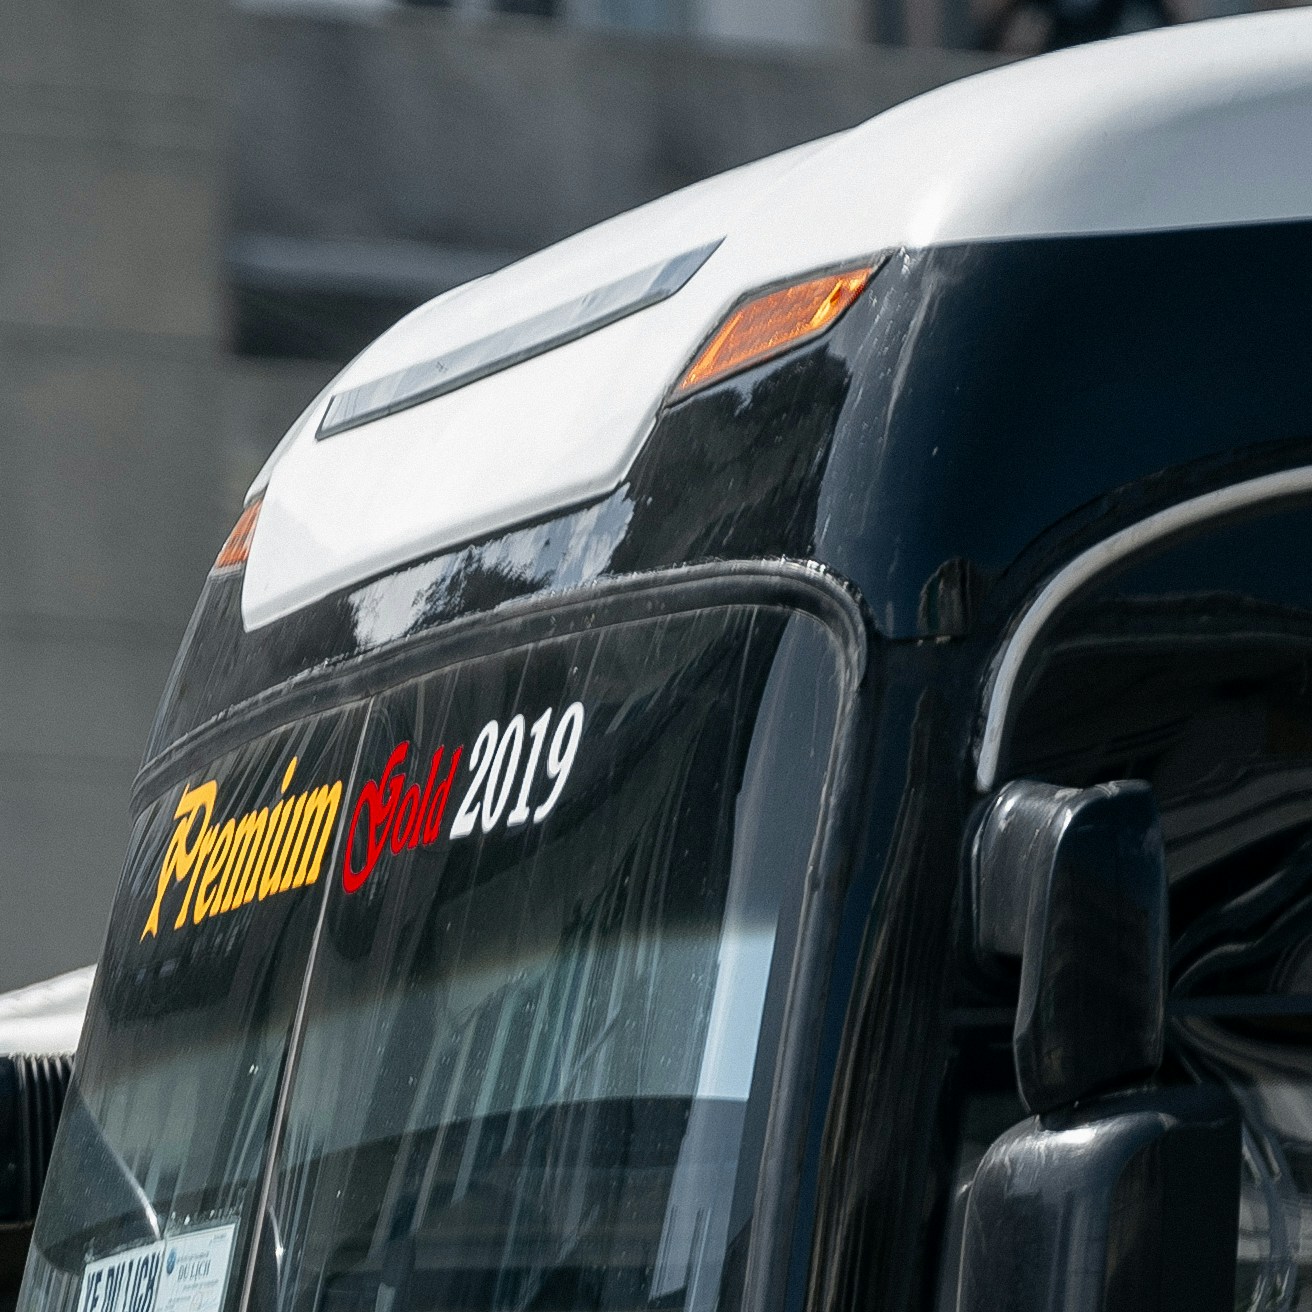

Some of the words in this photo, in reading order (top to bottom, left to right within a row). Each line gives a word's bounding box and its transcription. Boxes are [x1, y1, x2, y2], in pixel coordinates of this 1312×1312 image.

[140, 757, 343, 942] Premium
[342, 740, 464, 895] Gold
[449, 701, 585, 841] 2019
